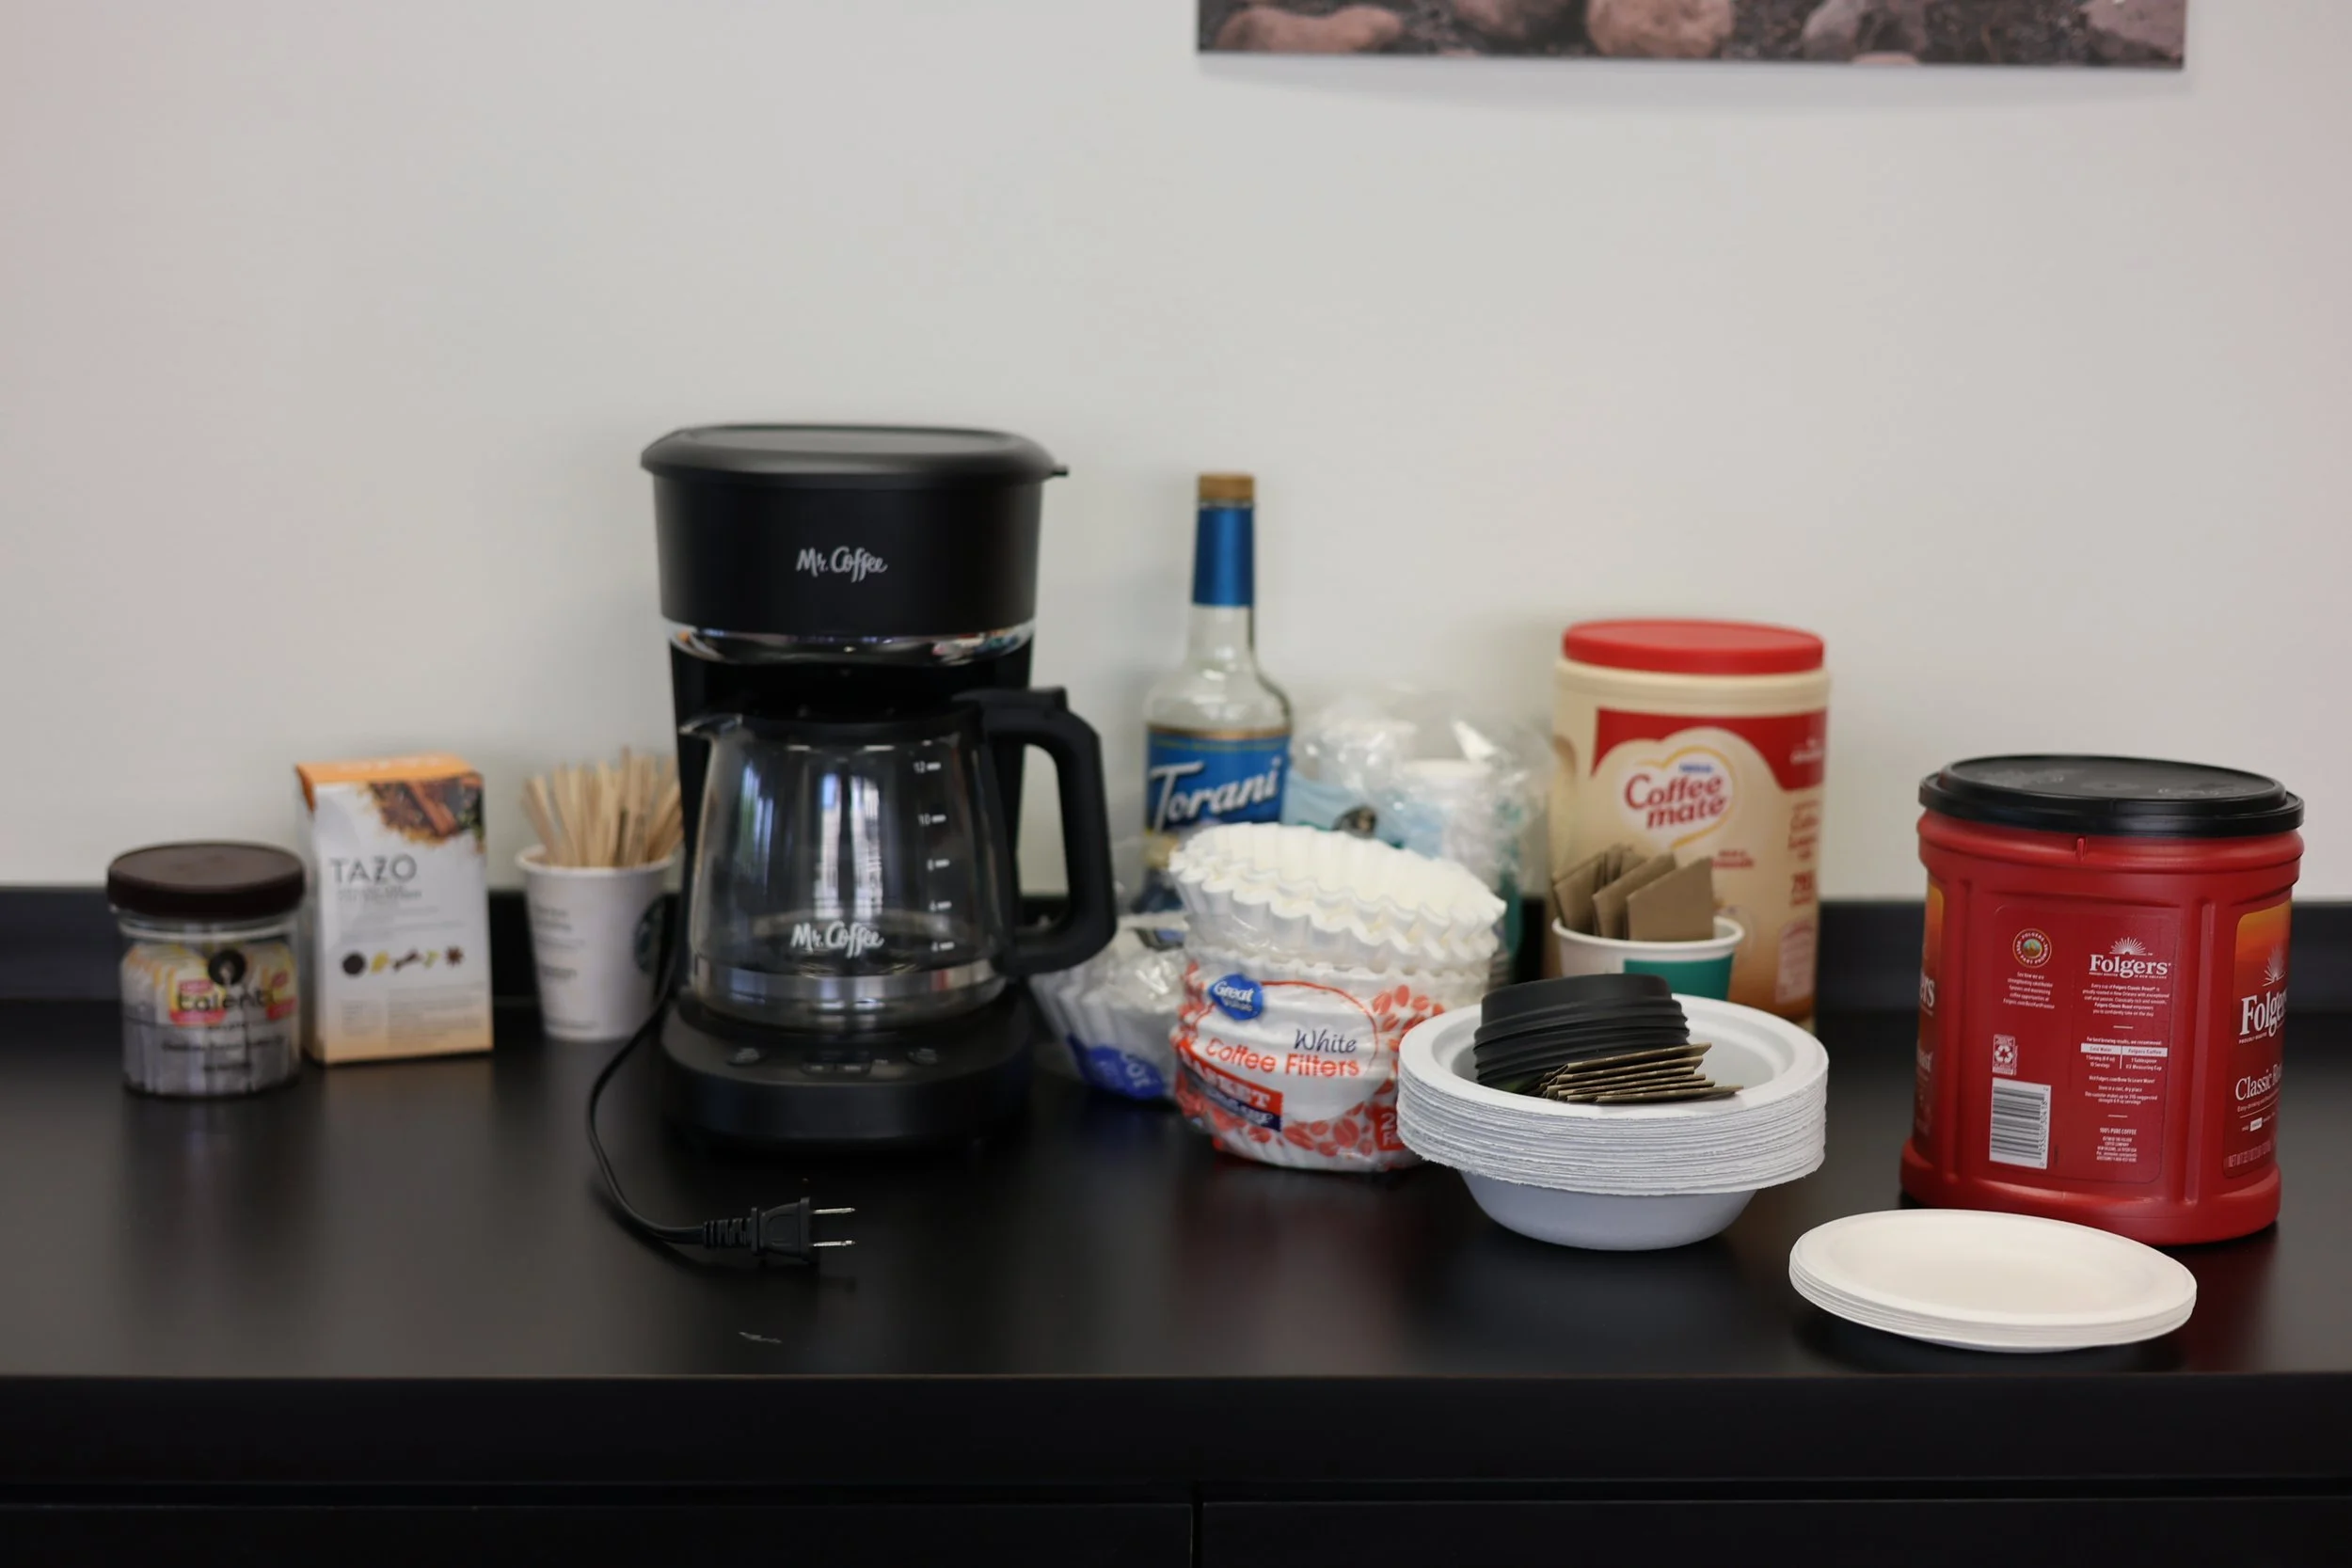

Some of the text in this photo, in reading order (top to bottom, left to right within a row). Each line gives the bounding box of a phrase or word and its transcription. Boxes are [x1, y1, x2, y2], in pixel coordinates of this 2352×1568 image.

[795, 545, 888, 583] Mr. Coffee
[1150, 755, 1282, 833] Torani
[1624, 772, 1724, 811] Coffee
[918, 814, 930, 826] 10
[1646, 796, 1727, 830] mate
[329, 853, 418, 884] TAZO
[789, 920, 884, 958] Mr. Coffee
[2089, 954, 2169, 978] Folgers
[1213, 980, 1254, 1004] Great
[2239, 988, 2288, 1037] Folger
[1205, 1037, 1359, 1077] Coffee Filters
[1294, 1028, 1358, 1053] White
[2235, 1069, 2273, 1101] Classic
